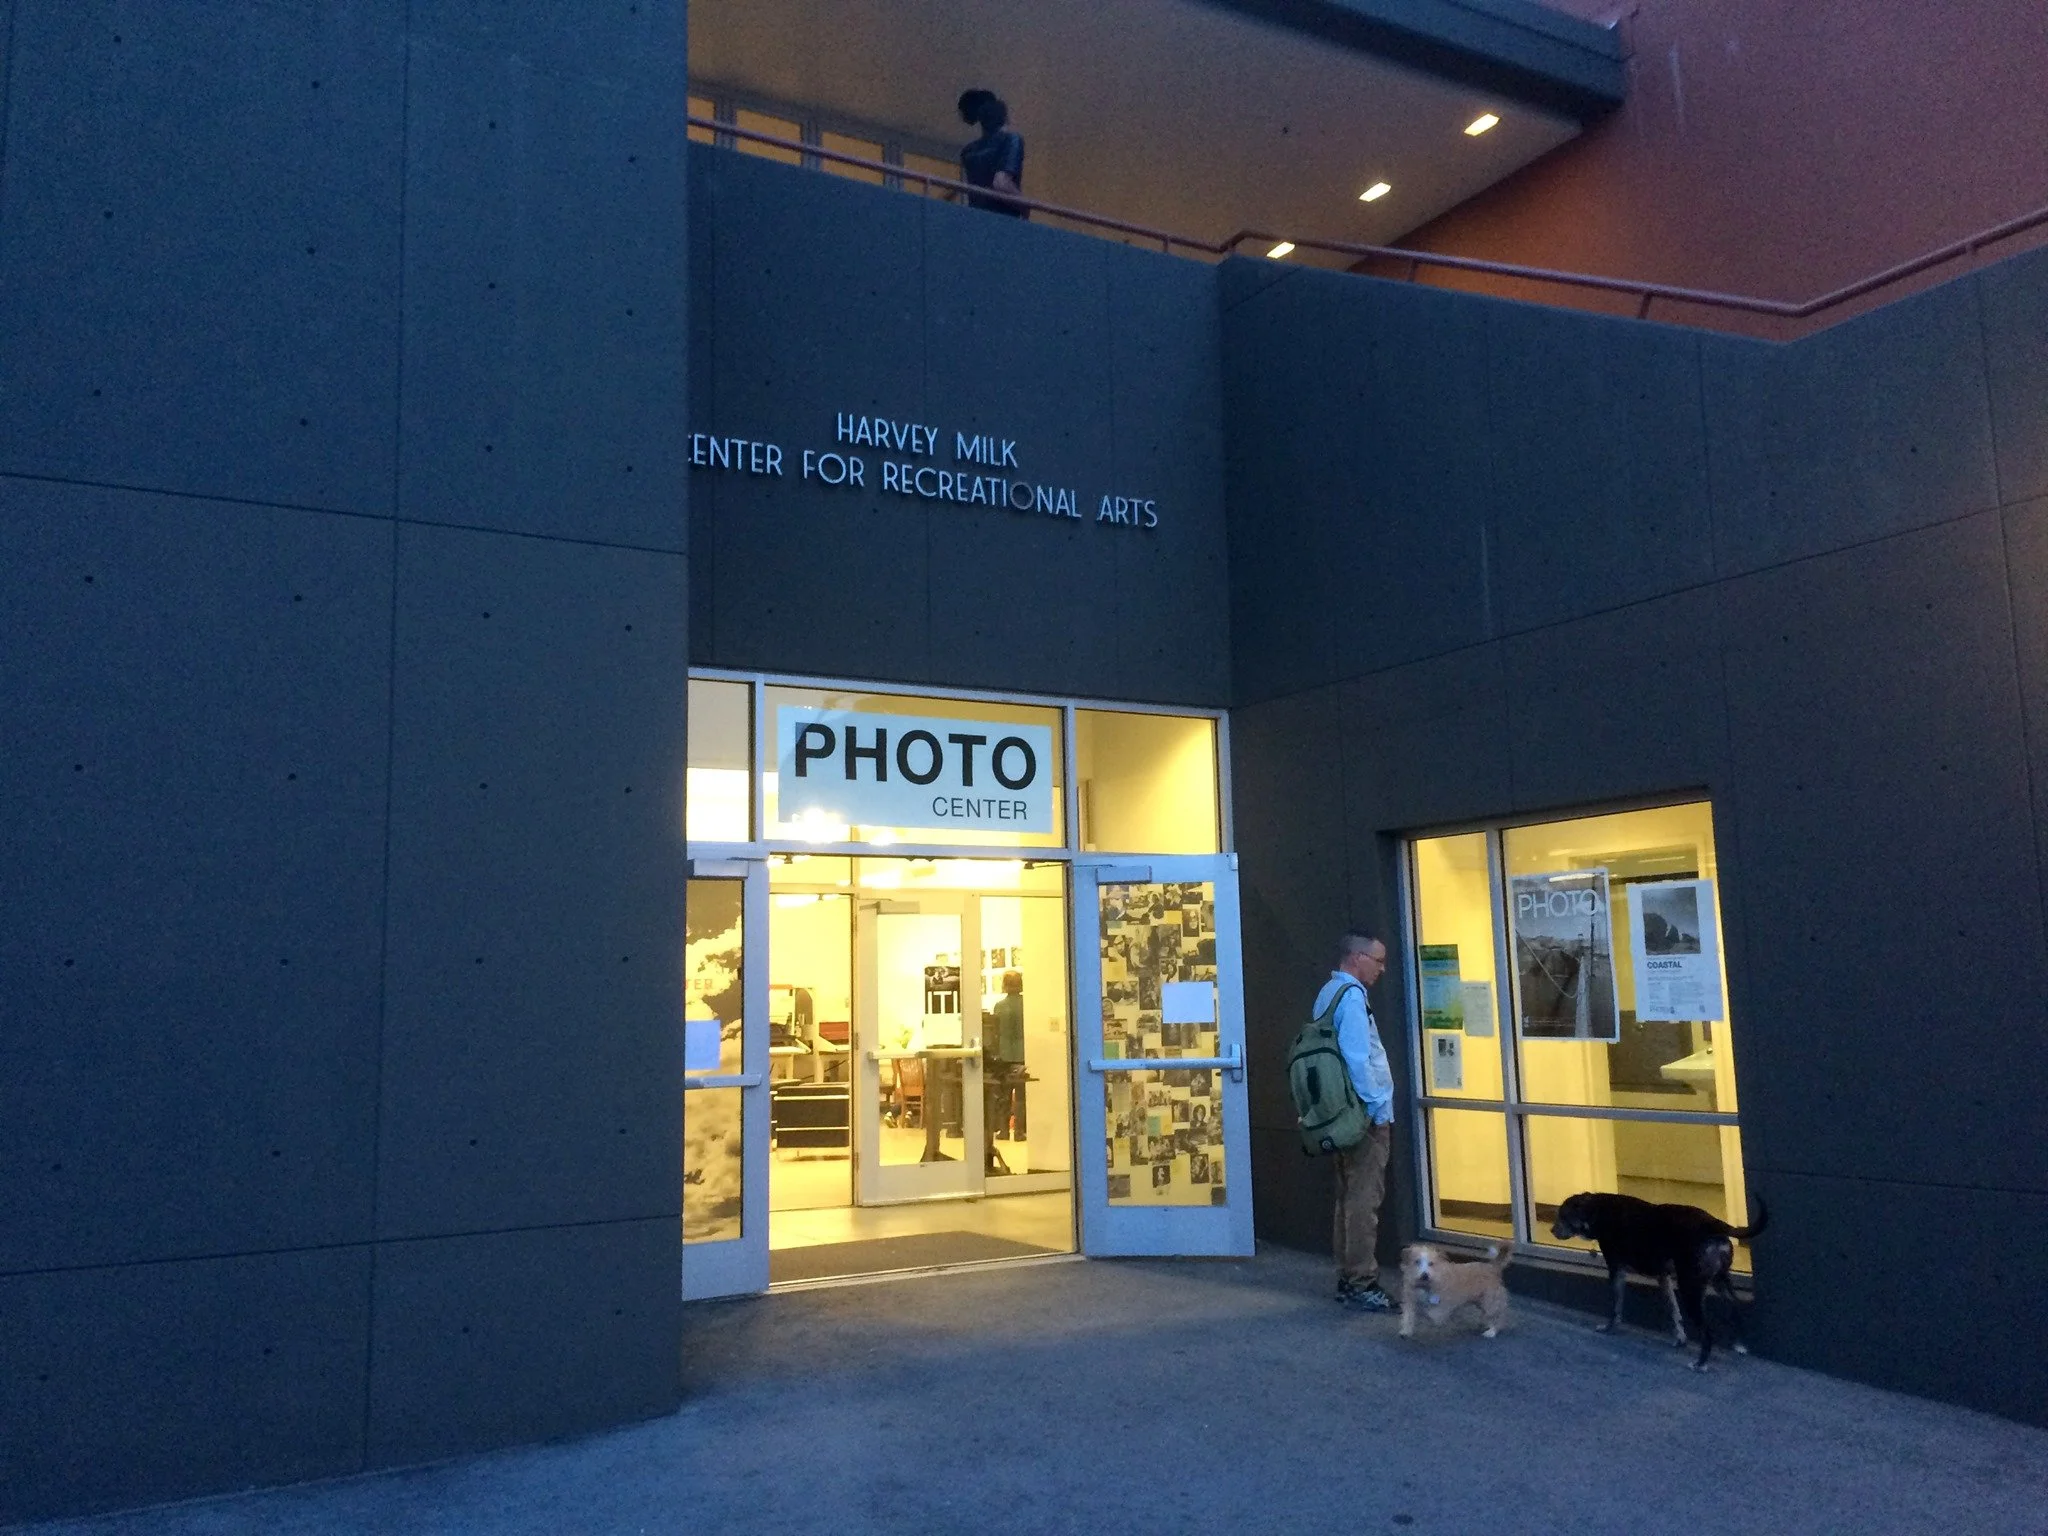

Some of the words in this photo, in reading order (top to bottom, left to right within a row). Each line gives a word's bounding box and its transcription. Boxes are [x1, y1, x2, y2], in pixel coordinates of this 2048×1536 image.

[837, 411, 938, 456] HARVEY
[956, 431, 1018, 468] MILK
[687, 432, 783, 476] ENTER
[803, 449, 865, 487] FOR
[883, 461, 1082, 518] RECREATIONAL
[1097, 494, 1159, 527] ARTS
[794, 721, 1037, 791] PHOTO
[932, 796, 1028, 820] CENTER
[1517, 888, 1600, 919] PHOTO
[1646, 961, 1683, 970] COASTAL
